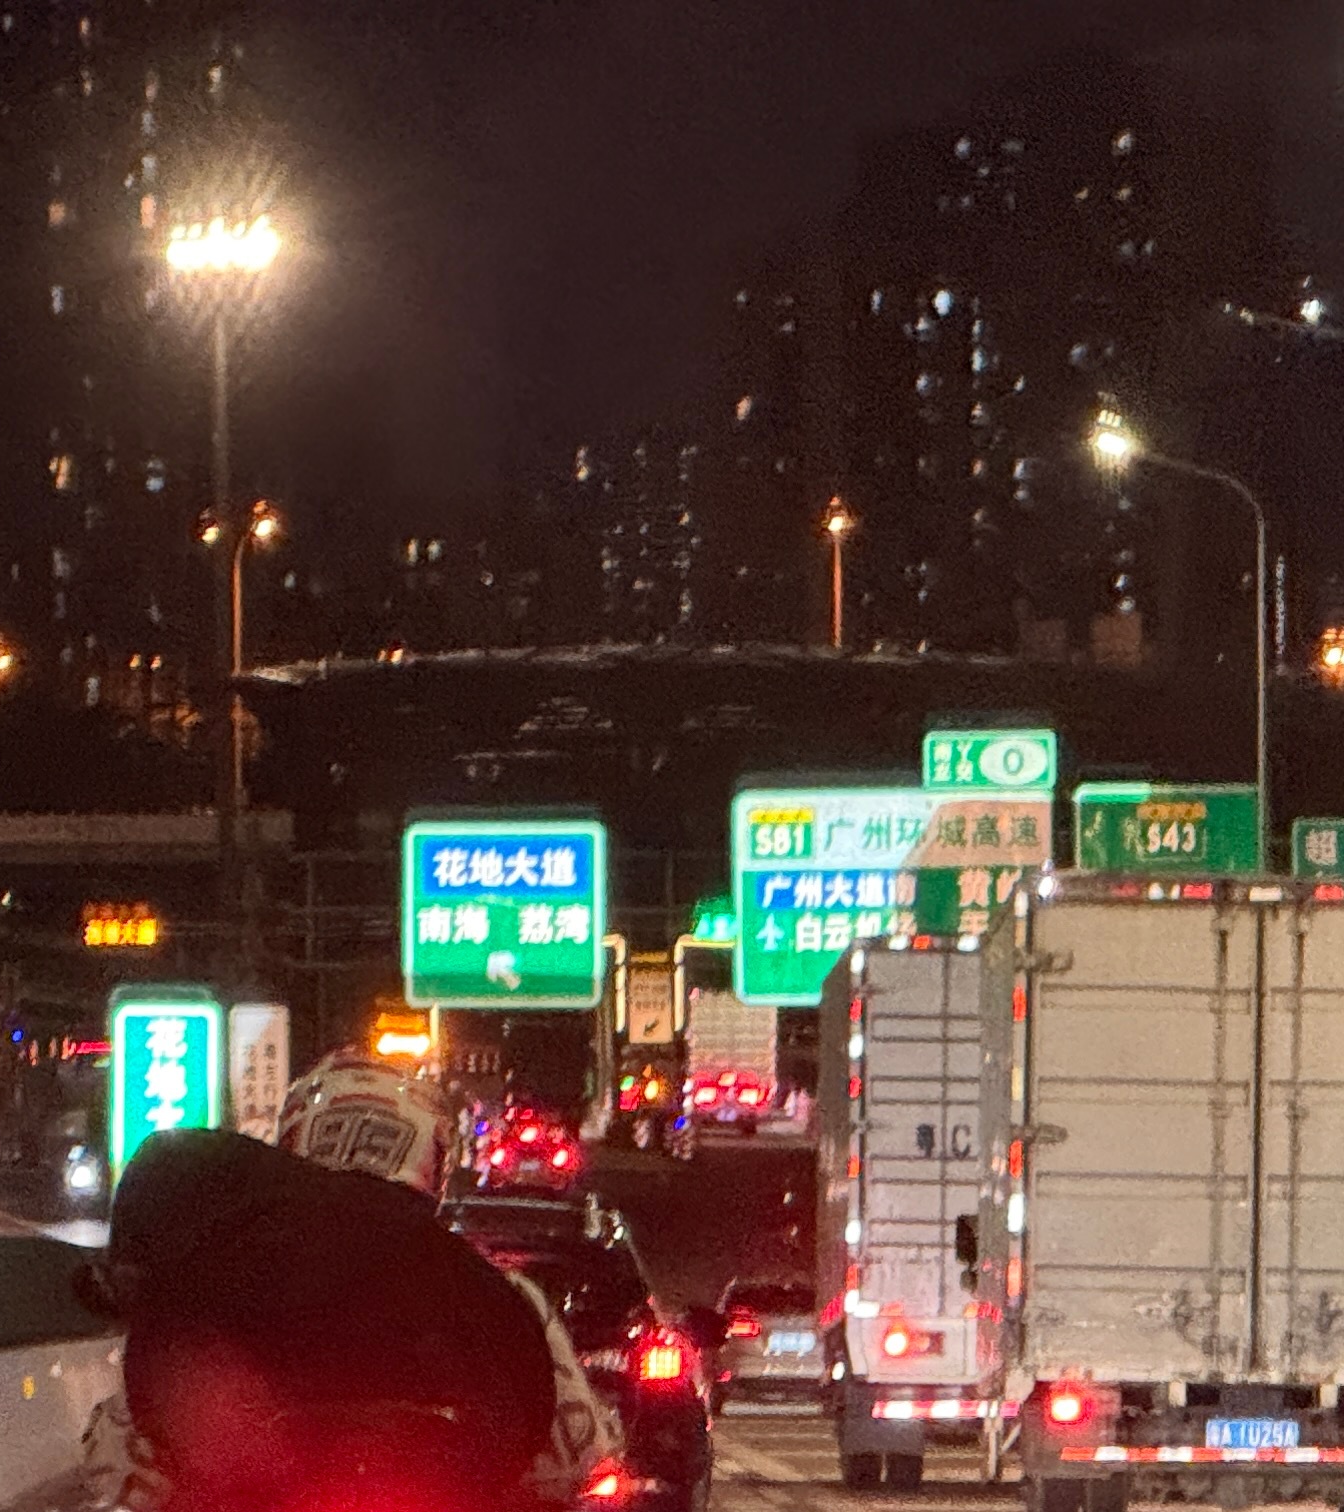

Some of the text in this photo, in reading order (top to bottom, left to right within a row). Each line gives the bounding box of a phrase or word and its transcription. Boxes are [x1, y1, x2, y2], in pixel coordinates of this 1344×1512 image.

[824, 814, 1040, 850] 广州环城高速
[1147, 822, 1196, 854] S43
[432, 846, 577, 888] 花地大道
[761, 872, 917, 908] 广州大道南
[416, 903, 591, 945] 南海 荔湾
